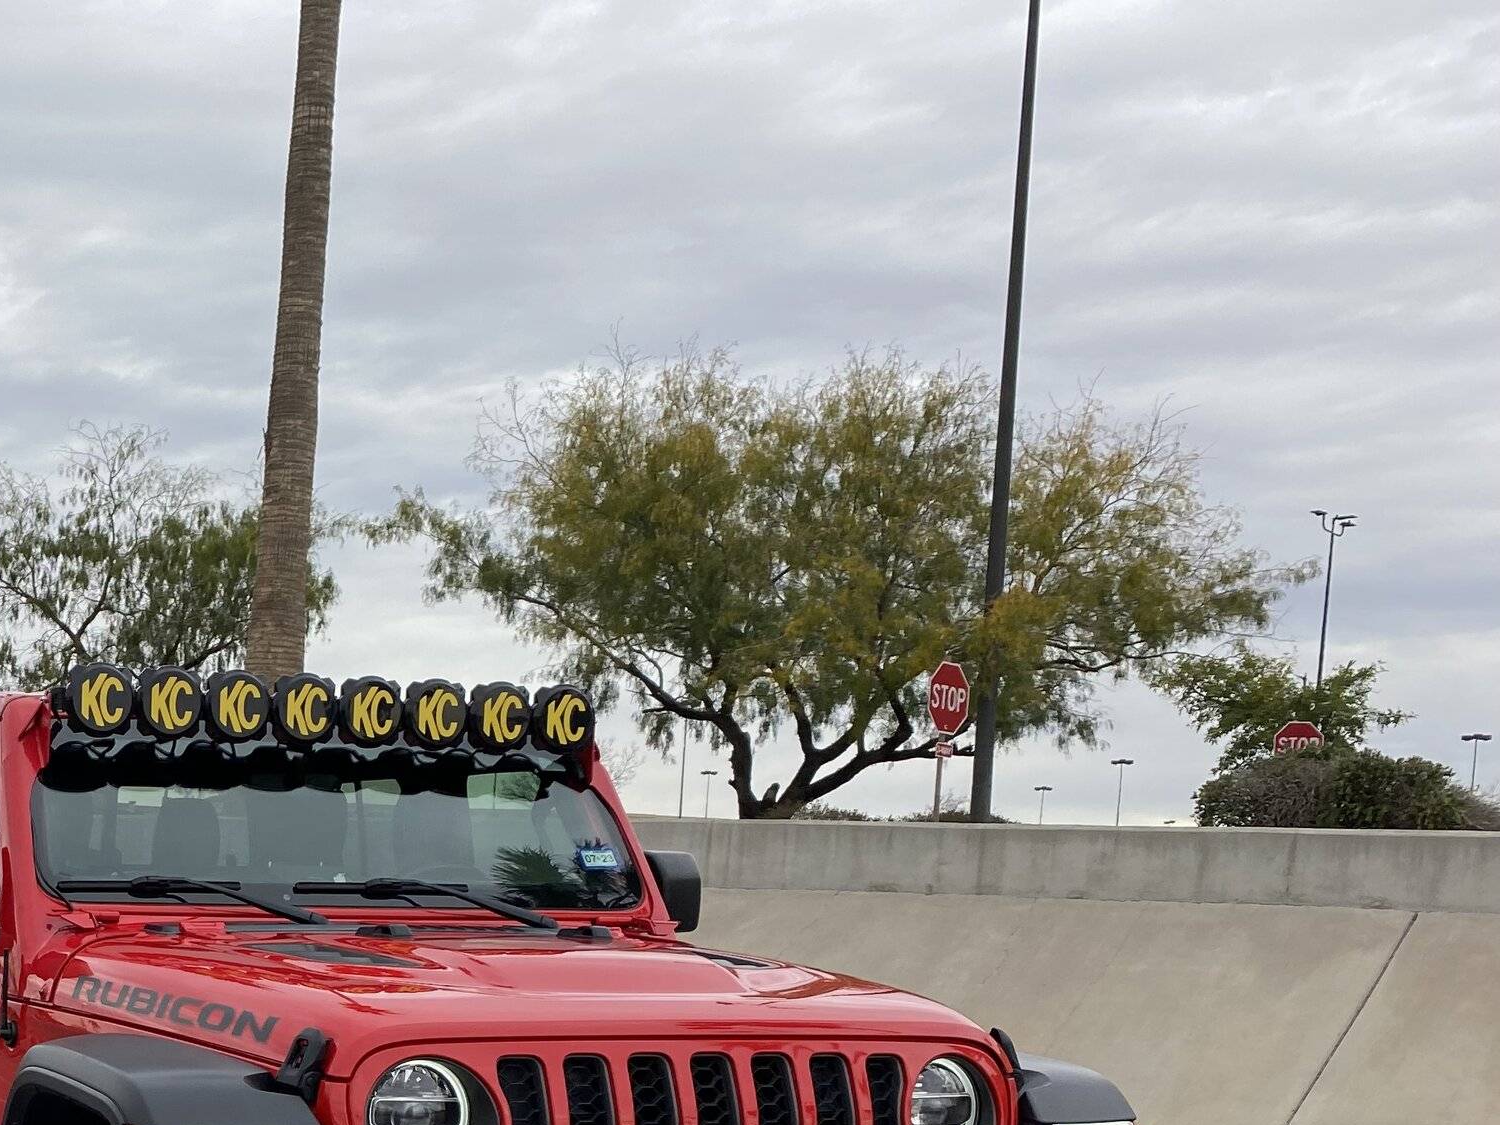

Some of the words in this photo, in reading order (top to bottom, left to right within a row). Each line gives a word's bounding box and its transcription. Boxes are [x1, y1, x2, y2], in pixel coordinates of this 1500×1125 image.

[81, 673, 123, 726] KC
[151, 677, 192, 729] KC
[220, 680, 260, 732] KC
[287, 684, 327, 735] KC
[353, 687, 393, 738] KC
[419, 689, 458, 740] KC
[483, 692, 522, 743] KC
[547, 694, 585, 745] KC
[931, 683, 966, 712] STOP
[72, 975, 281, 1044] RUBICON
